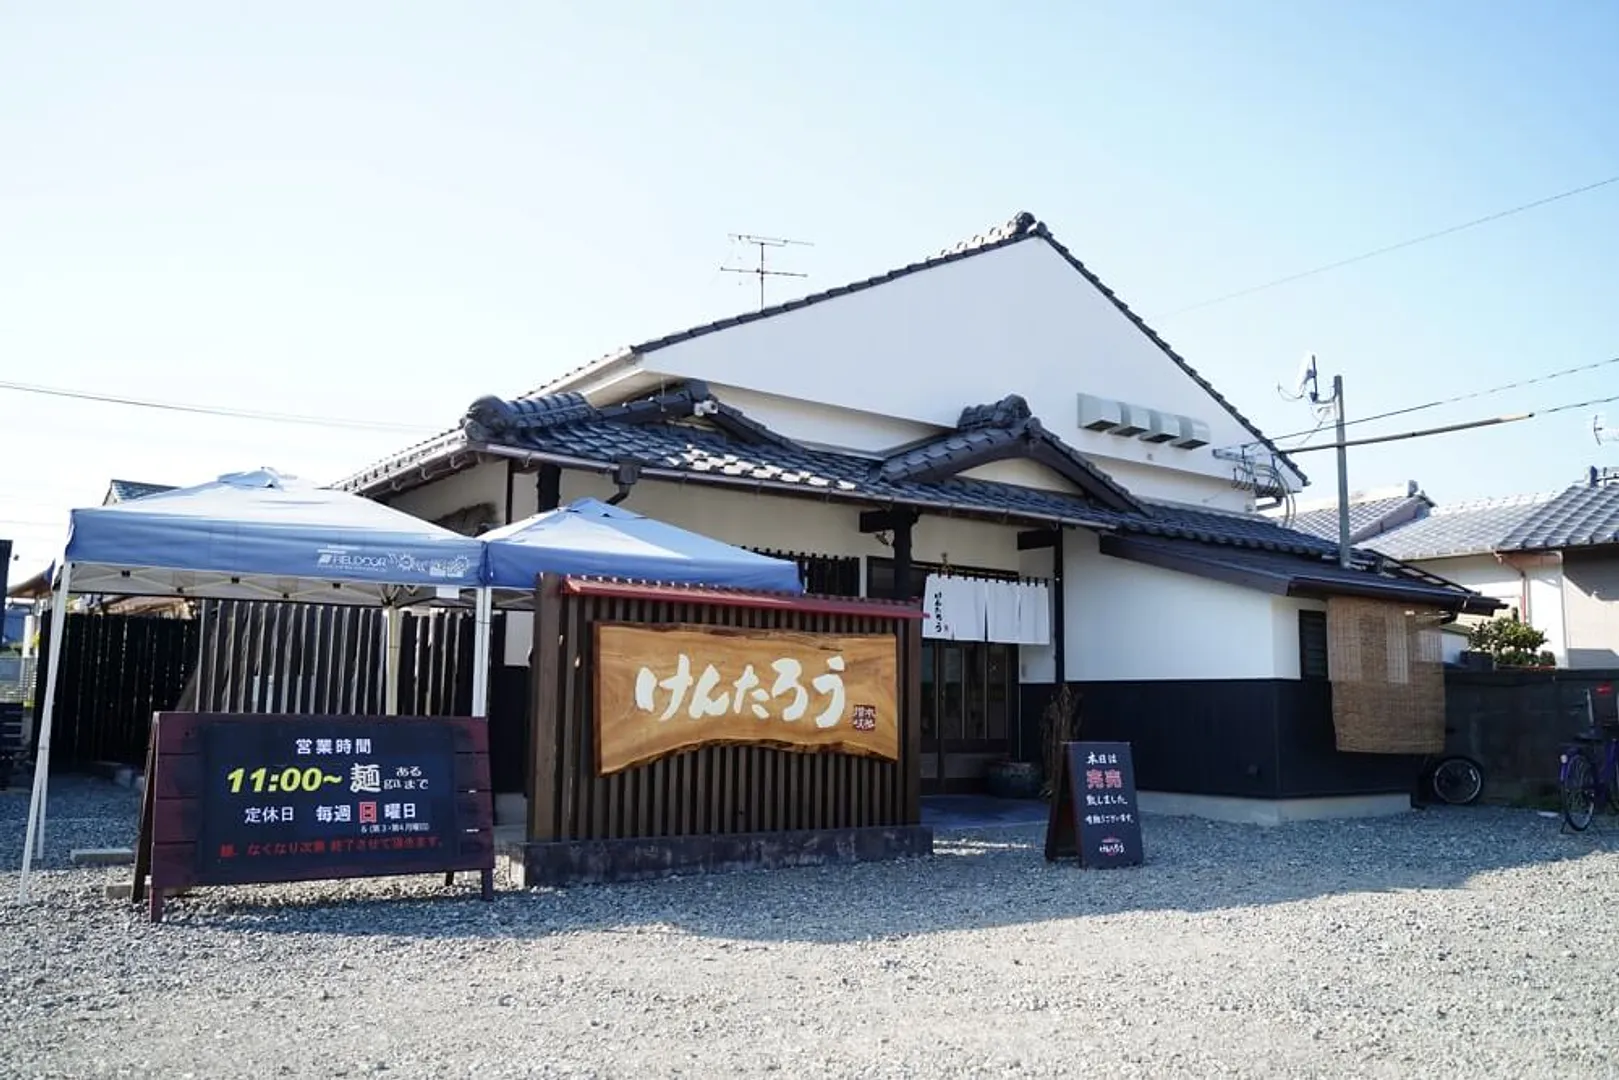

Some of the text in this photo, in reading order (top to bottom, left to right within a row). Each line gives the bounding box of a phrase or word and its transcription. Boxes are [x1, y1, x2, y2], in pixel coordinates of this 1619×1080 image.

[934, 591, 943, 633] けんたろう
[635, 653, 845, 728] けんたろう
[296, 738, 372, 755] 営業時間
[1086, 751, 1117, 765] 本日は
[350, 763, 382, 794] 麺
[395, 765, 422, 777] ある
[1086, 769, 1122, 789] 完売
[244, 807, 294, 824] 定休日
